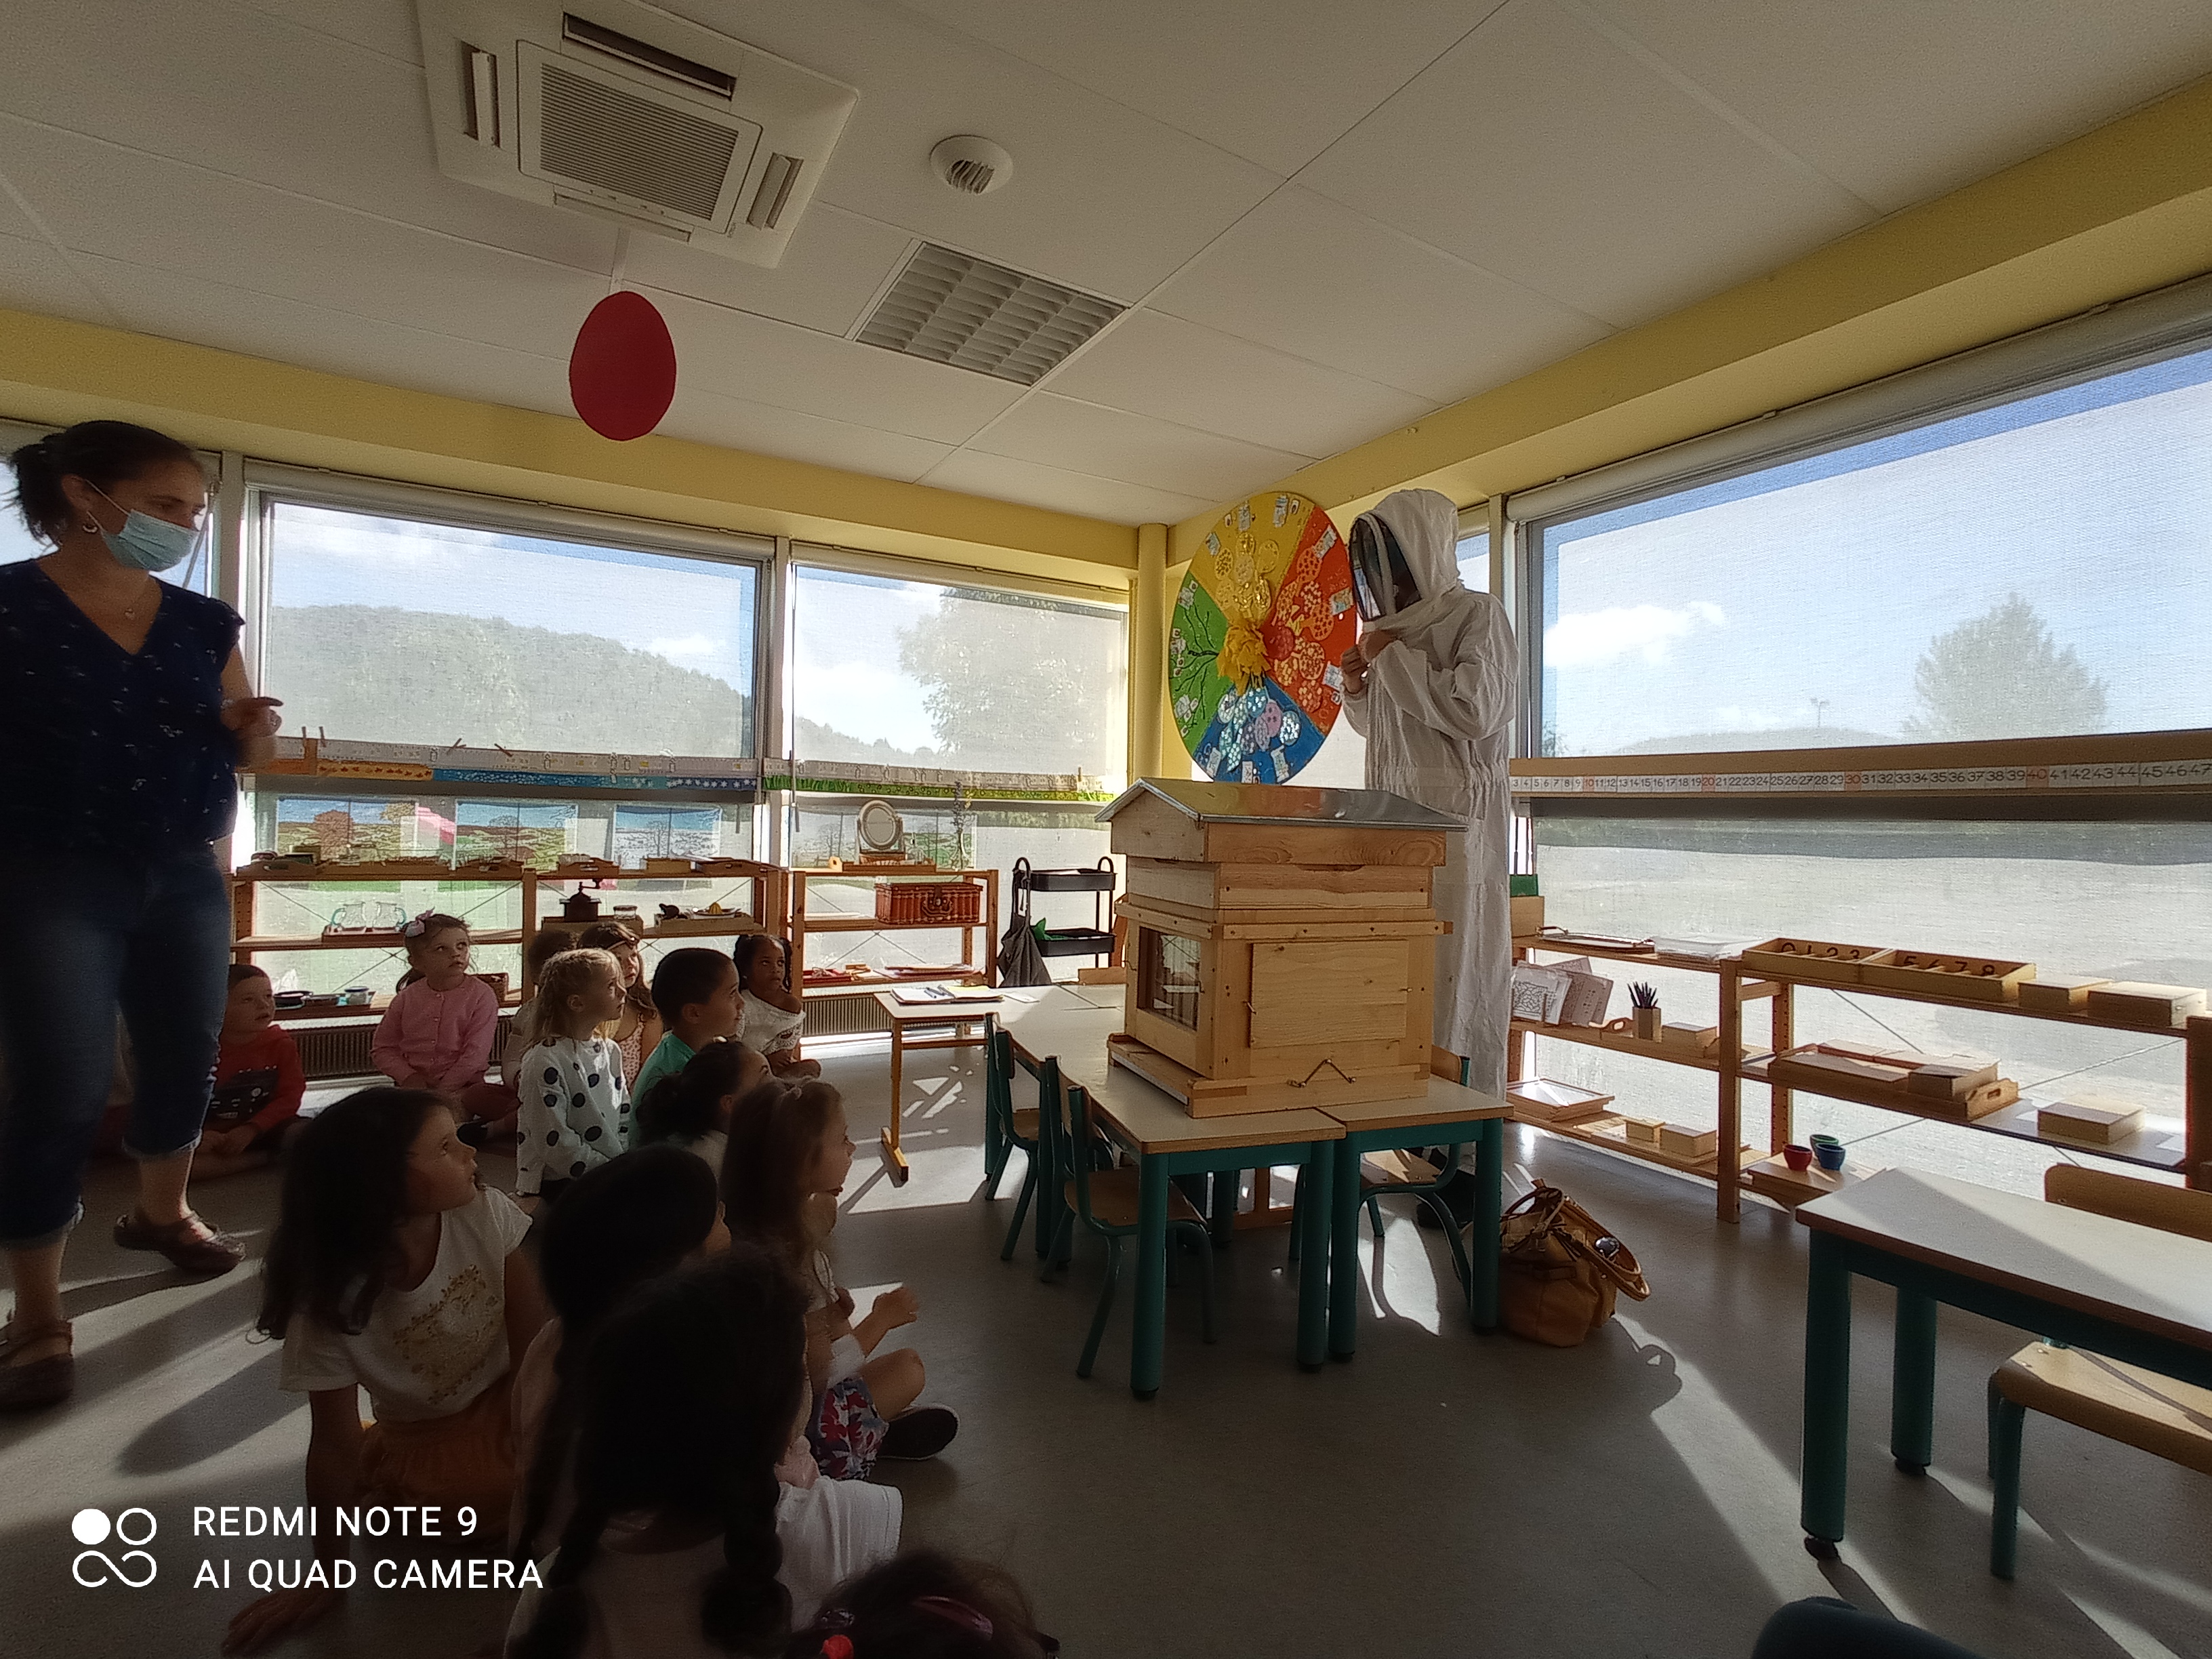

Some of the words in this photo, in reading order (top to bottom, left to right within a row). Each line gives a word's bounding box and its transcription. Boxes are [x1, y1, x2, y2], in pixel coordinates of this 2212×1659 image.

[1534, 779, 1539, 787] 5
[1544, 779, 1549, 787] 6
[1642, 779, 1651, 787] 15
[1679, 778, 1689, 786] 18
[1692, 777, 1702, 786] 19
[1702, 777, 1715, 786] 20
[1716, 777, 1727, 786] 21
[1729, 777, 1741, 786] 22
[1743, 777, 1755, 785] 23
[1757, 776, 1768, 785] 24
[1771, 776, 1783, 785] 25
[1785, 776, 1798, 785] 26
[1799, 776, 1814, 785] 27
[1815, 775, 1828, 785] 28
[1830, 775, 1843, 785] 29
[1845, 775, 1861, 784] 30
[1862, 775, 1875, 783] 31
[1878, 774, 1893, 783] 32
[1896, 773, 1910, 783] 33
[1913, 773, 1928, 783] 34
[1932, 772, 1948, 782] 35
[1949, 772, 1965, 782] 36
[1967, 771, 1985, 781] 37
[1986, 771, 2005, 781] 38
[2007, 770, 2026, 781] 39
[2027, 769, 2047, 779] 40
[2050, 770, 2067, 779] 41
[2071, 769, 2091, 779] 42
[2093, 768, 2113, 779] 43
[2117, 766, 2137, 777] 44
[2142, 766, 2163, 777] 45
[2165, 765, 2187, 777] 46
[2190, 764, 2212, 775] 47
